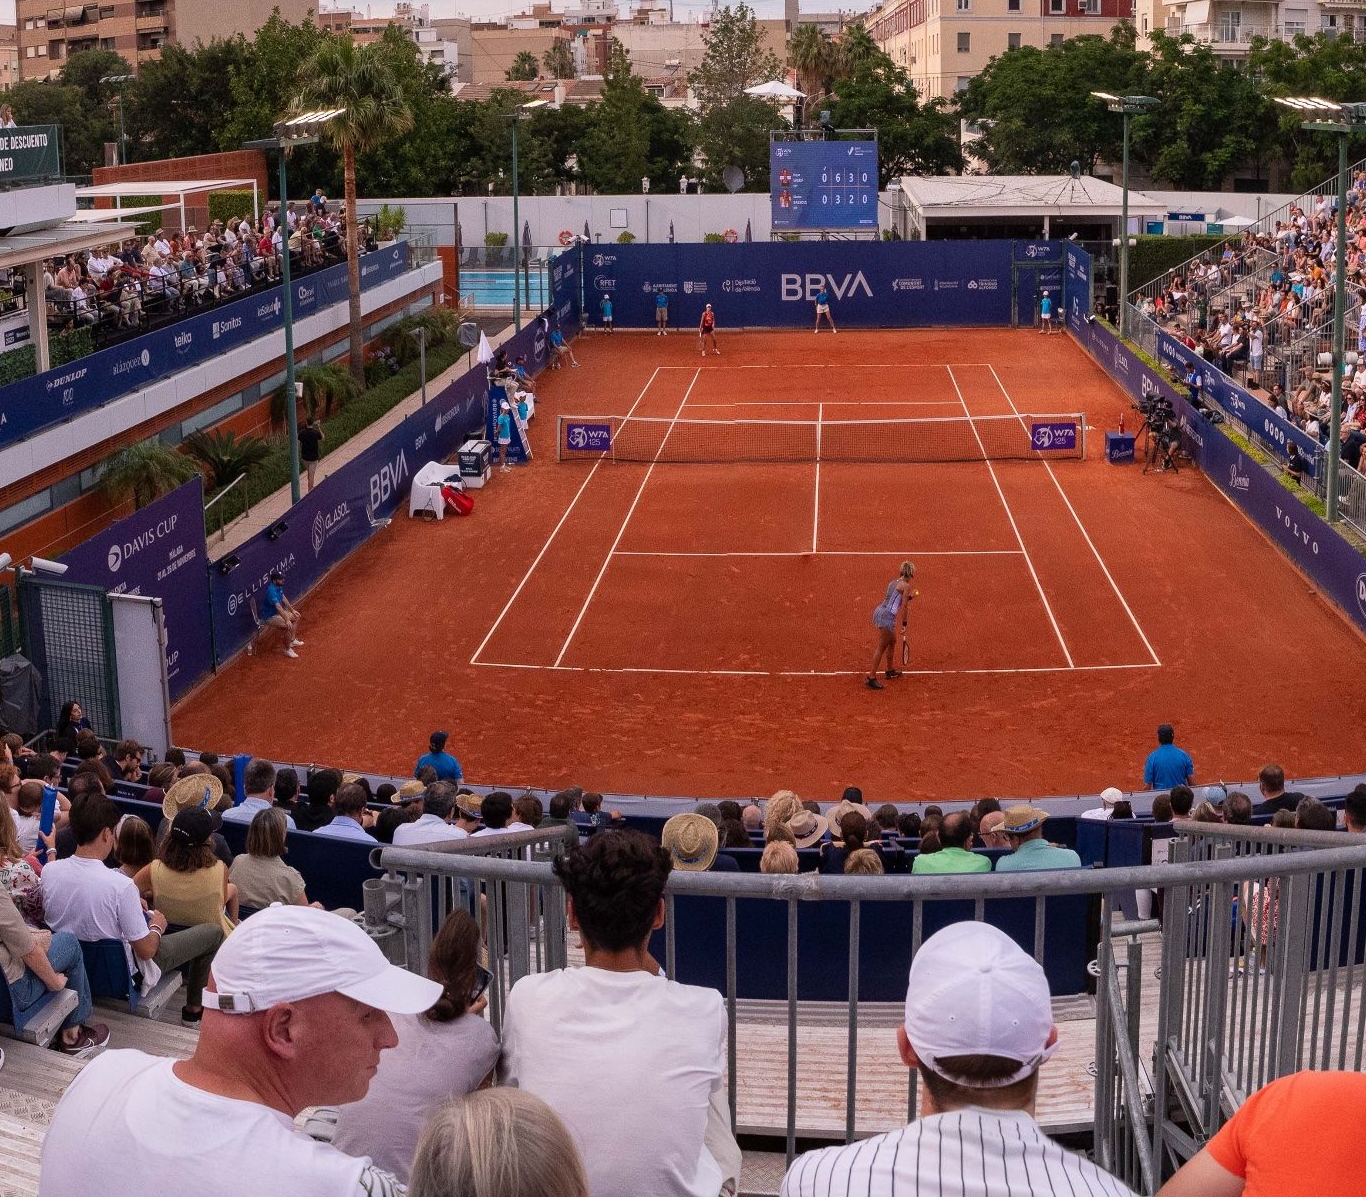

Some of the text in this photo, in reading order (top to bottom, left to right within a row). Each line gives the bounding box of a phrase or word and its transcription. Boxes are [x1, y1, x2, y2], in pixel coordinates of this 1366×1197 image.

[0, 137, 9, 151] DE
[10, 133, 48, 150] DESCUENTO
[822, 173, 868, 183] 0 6 3 0
[822, 195, 868, 204] 0 3 2 0
[781, 270, 874, 301] BBVA
[220, 315, 241, 333] Sanitas
[174, 332, 192, 348] teika
[53, 368, 87, 388] DUNLOP
[415, 431, 427, 451] BBVA
[369, 449, 409, 512] BBVA
[324, 501, 349, 530] GLASOL
[123, 514, 178, 560] DAVIS CUP
[1275, 506, 1319, 554] VOLVO
[168, 544, 184, 560] MÁLAGA
[162, 568, 167, 579] AL
[172, 562, 177, 572] DE
[177, 548, 196, 569] NOVIEMBRE
[166, 650, 179, 667] UP
